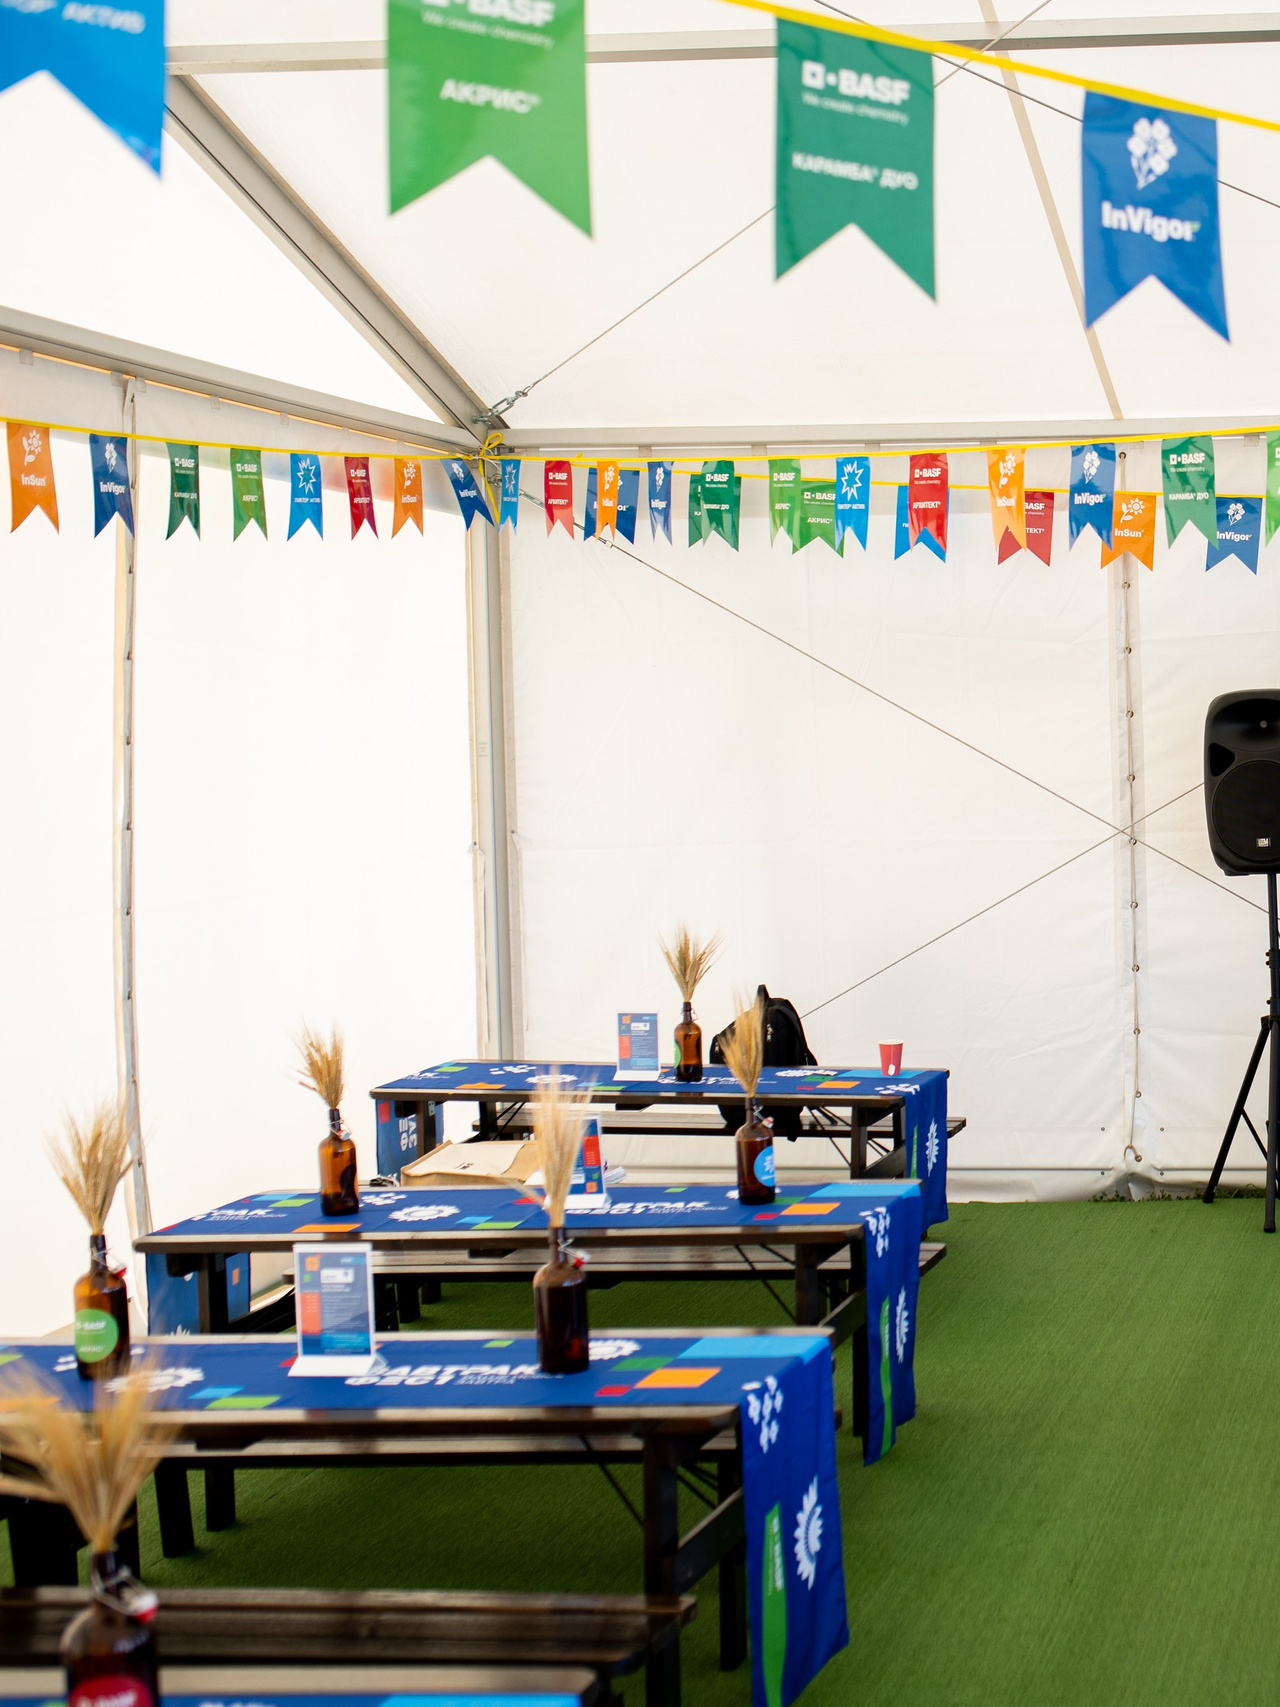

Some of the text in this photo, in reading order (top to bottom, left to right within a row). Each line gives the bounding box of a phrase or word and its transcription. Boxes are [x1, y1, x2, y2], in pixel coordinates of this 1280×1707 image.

[838, 68, 911, 105] BASF
[1101, 200, 1201, 243] InVigor
[182, 459, 195, 468] BASF
[1182, 453, 1205, 464] BASF
[244, 464, 257, 473] BASF
[923, 468, 941, 478] BASF
[21, 474, 45, 486] InSun
[780, 473, 795, 481] BASF
[100, 482, 125, 495] InVigor
[996, 495, 1016, 507] InSun
[1074, 492, 1104, 507] InVigor
[1114, 528, 1142, 538] InSun
[1217, 531, 1250, 541] InVigor
